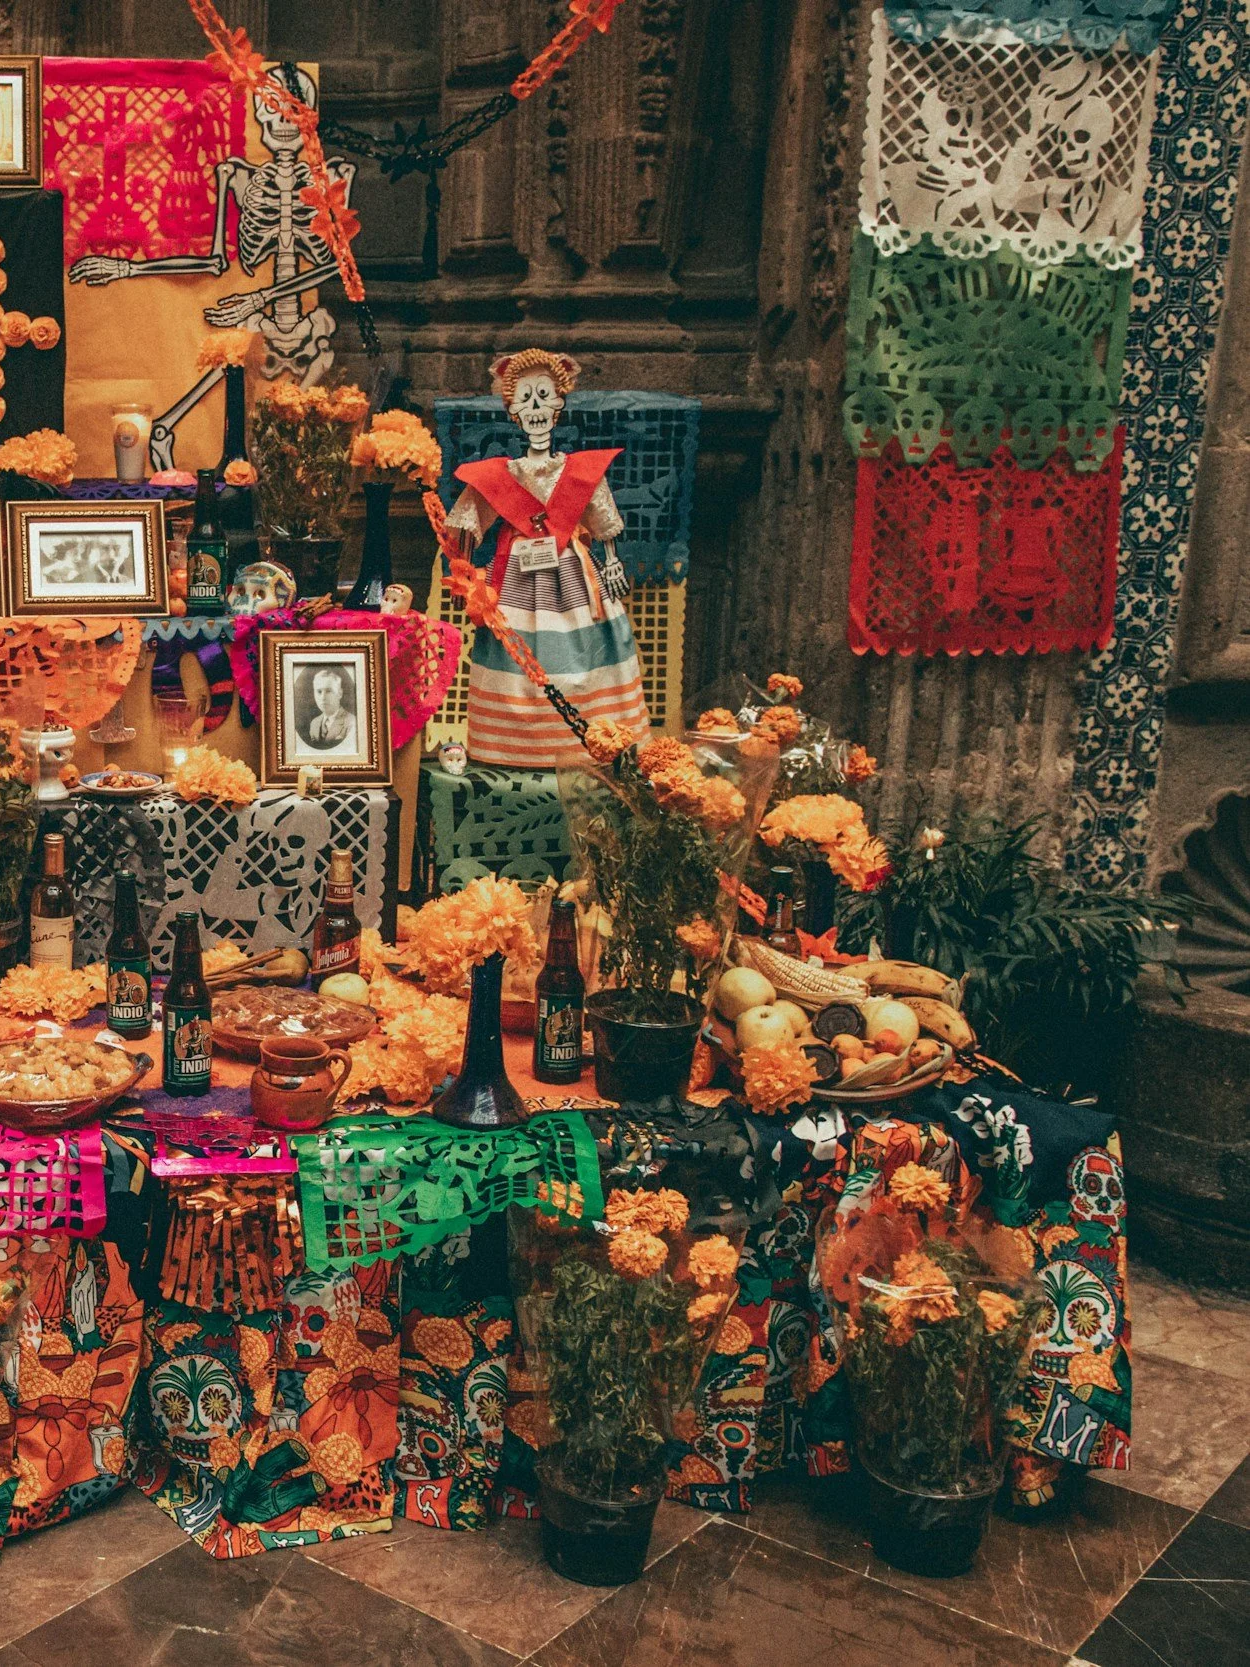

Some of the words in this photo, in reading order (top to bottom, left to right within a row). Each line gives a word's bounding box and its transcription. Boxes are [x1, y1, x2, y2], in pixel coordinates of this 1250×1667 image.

[190, 586, 217, 598] INDIO
[315, 946, 351, 970] Bohemia
[112, 1005, 144, 1019] INDIO
[181, 1057, 211, 1074] INDIO
